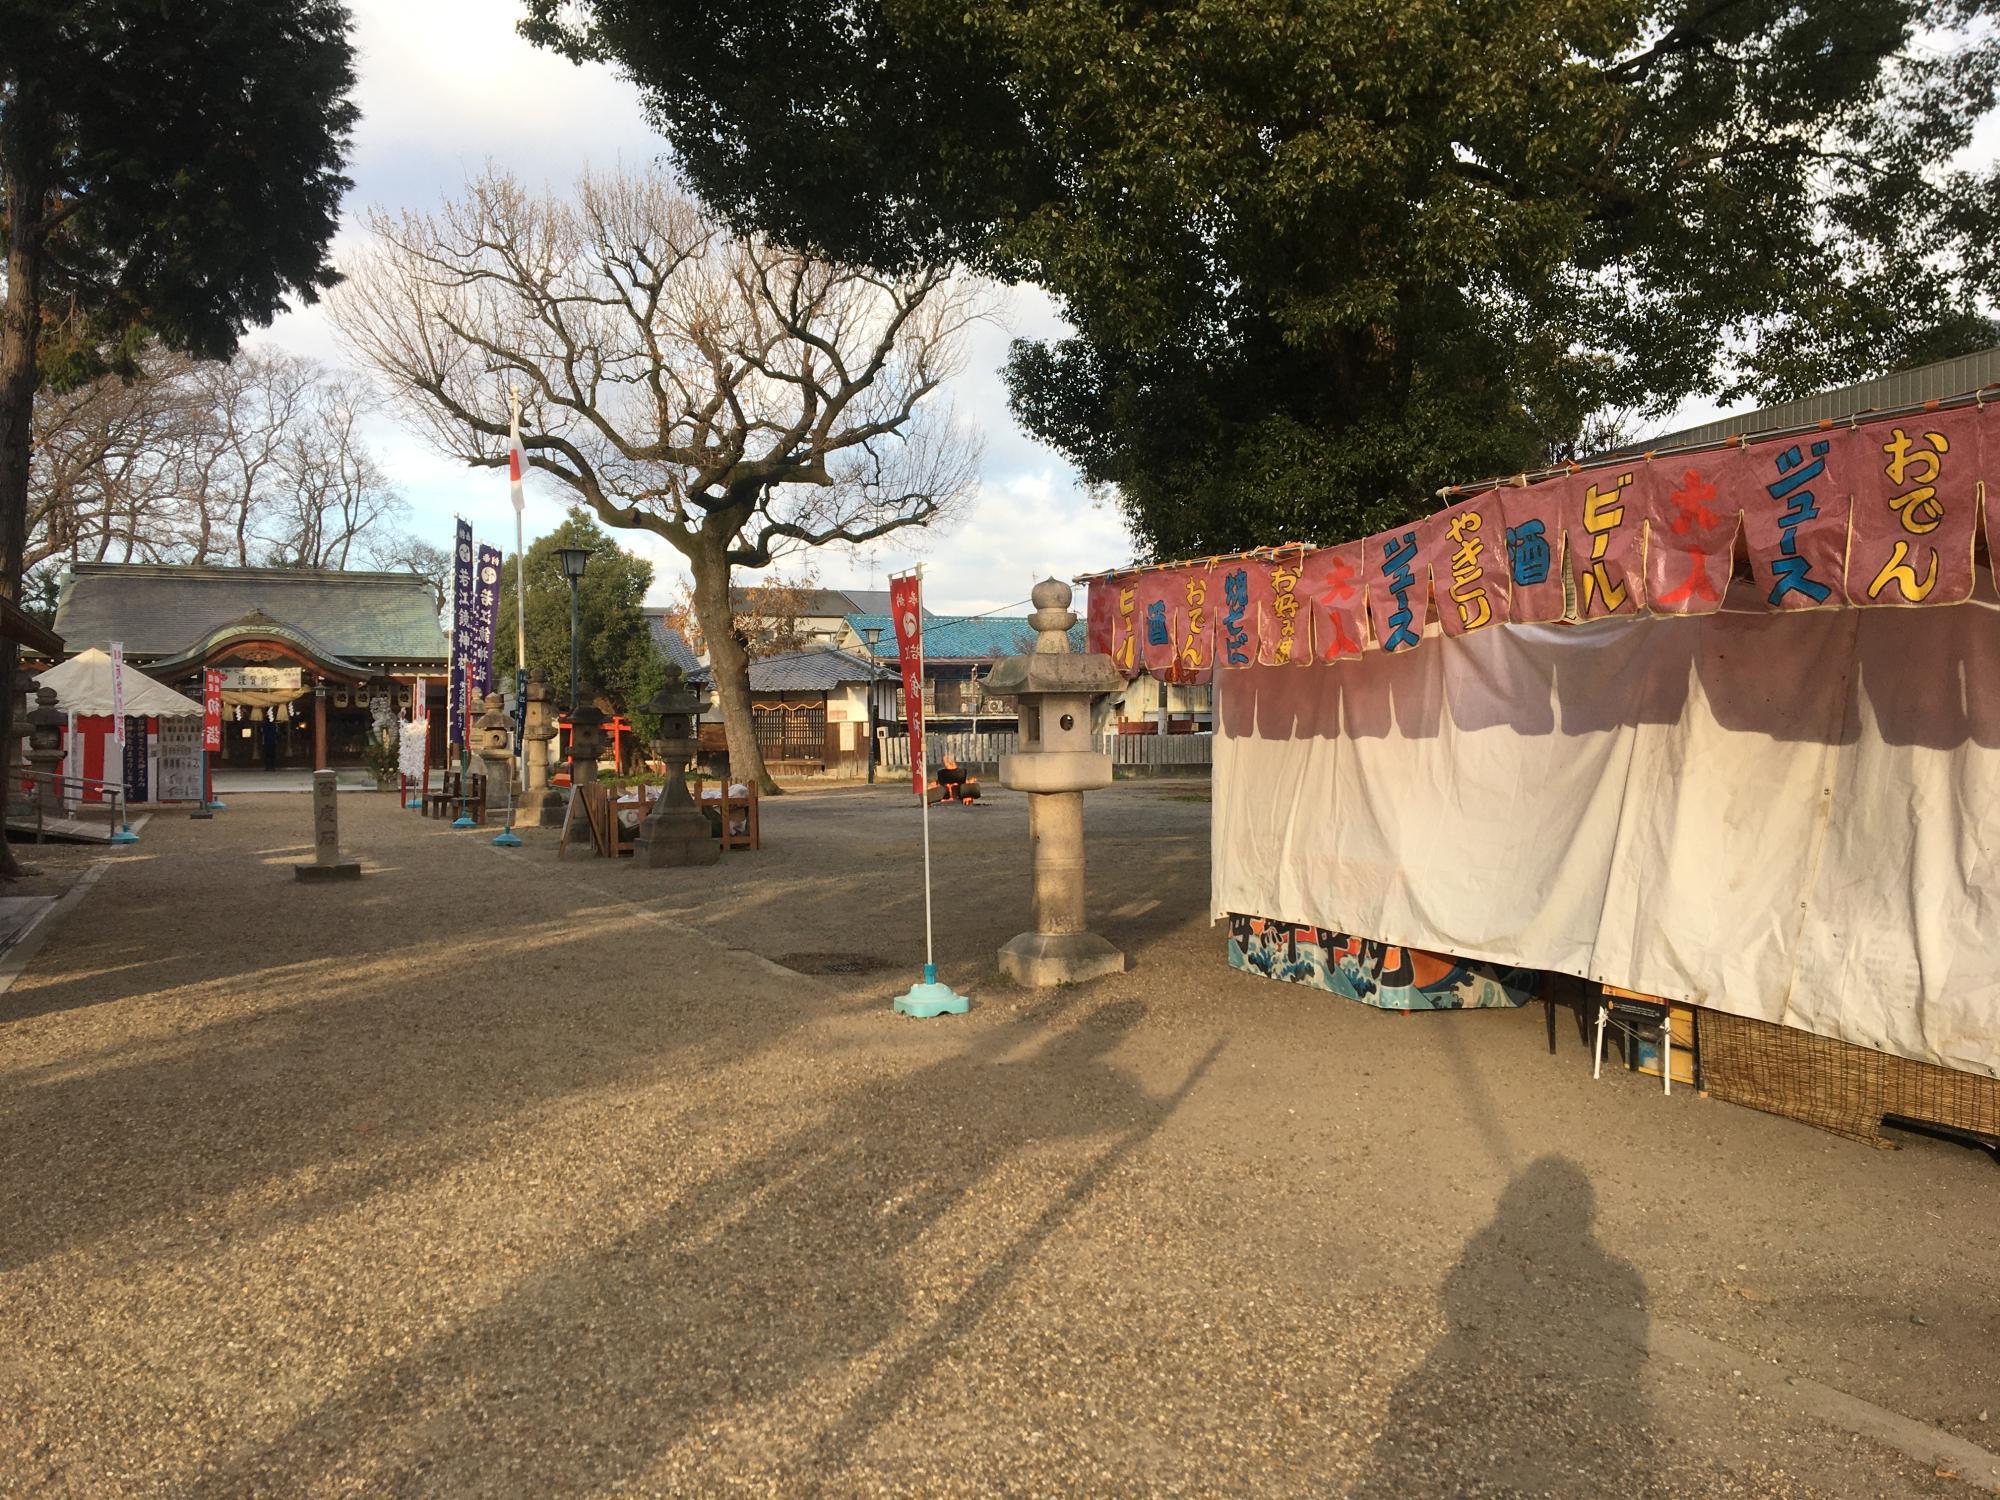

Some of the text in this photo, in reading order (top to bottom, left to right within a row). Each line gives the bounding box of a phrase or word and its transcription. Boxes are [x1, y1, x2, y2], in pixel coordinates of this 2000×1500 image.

[1446, 510, 1491, 630] やきとり
[1507, 518, 1551, 587] 酒
[1582, 472, 1634, 615] ビール
[1767, 439, 1832, 607] ジュース
[1868, 427, 1950, 603] おでん
[1116, 581, 1139, 670] ビール
[1182, 575, 1208, 666] おでん
[1381, 533, 1424, 652] ジュース
